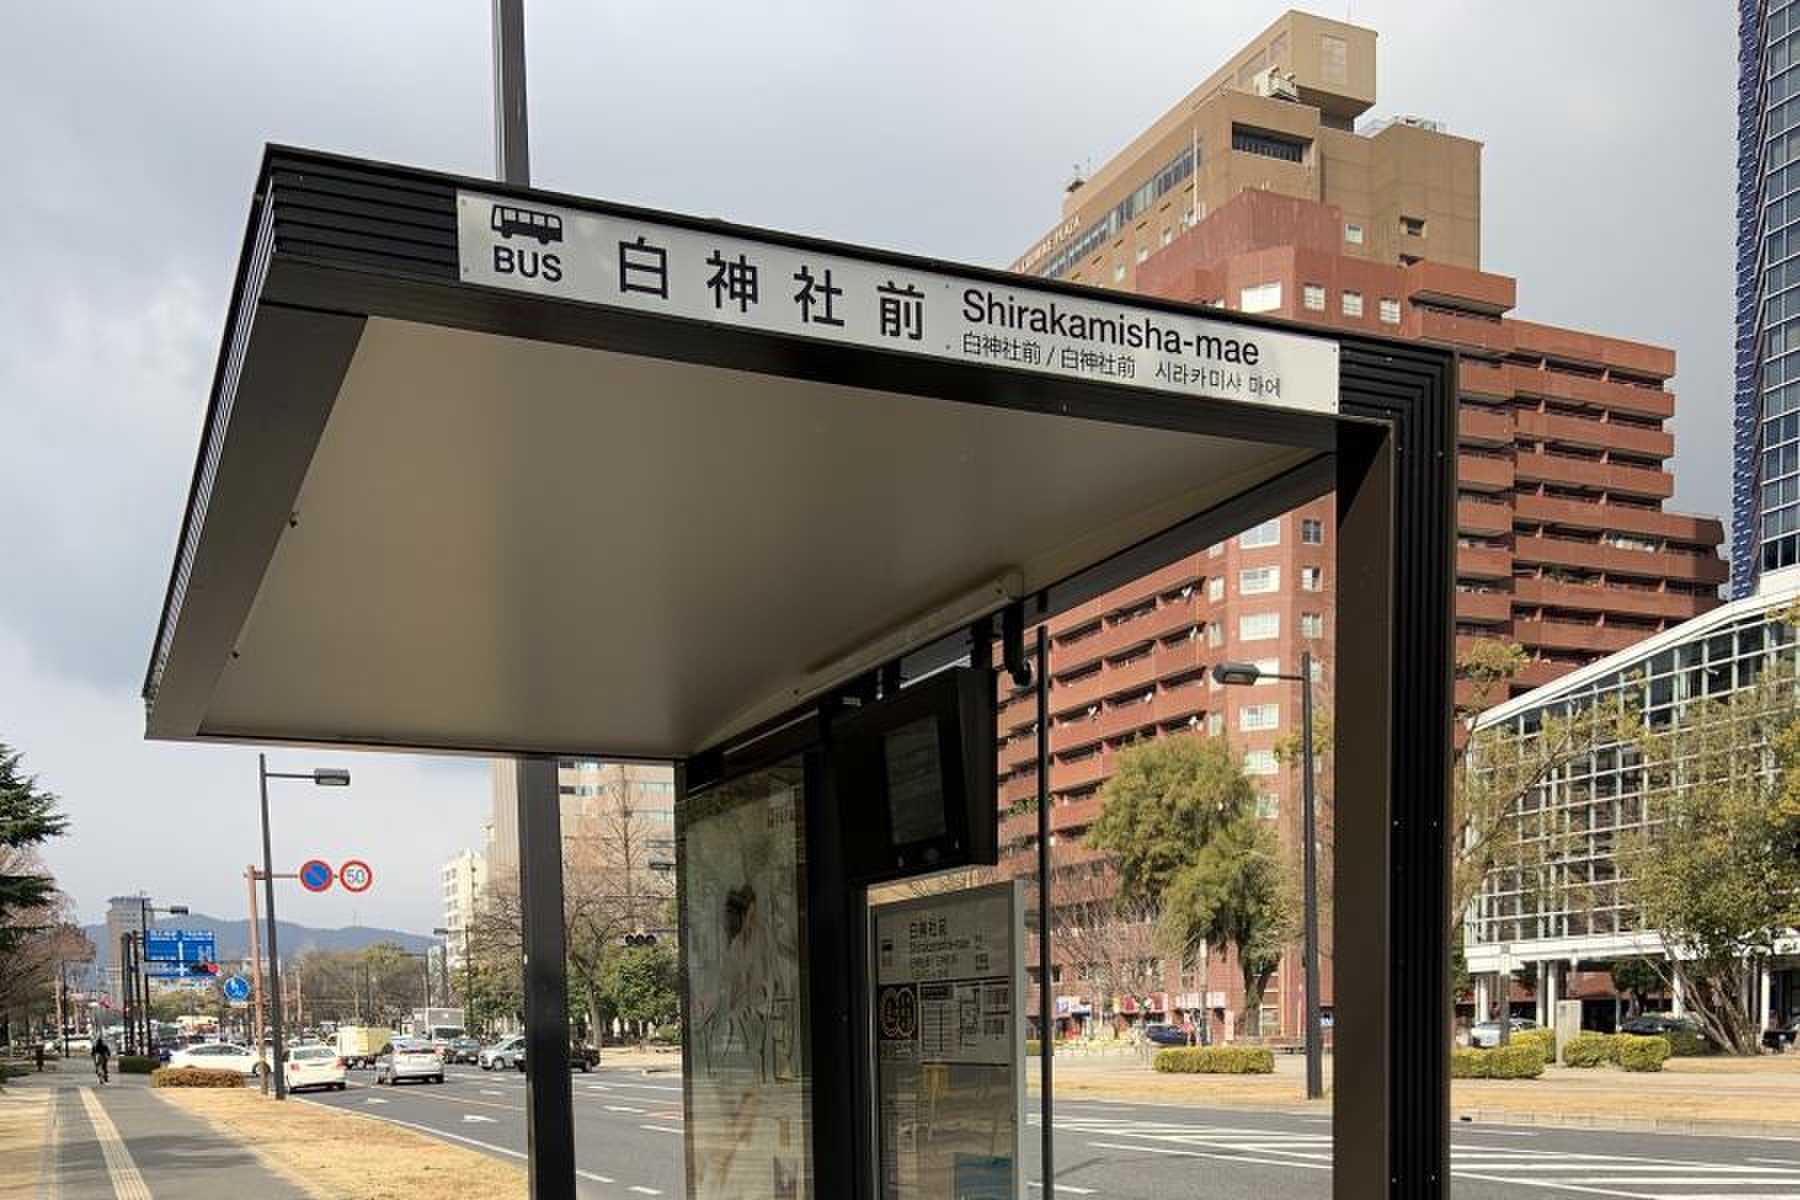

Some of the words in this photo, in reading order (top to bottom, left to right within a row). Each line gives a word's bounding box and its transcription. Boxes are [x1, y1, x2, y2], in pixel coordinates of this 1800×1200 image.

[494, 244, 563, 283] BUS
[618, 236, 927, 341] 白神社前
[961, 288, 1260, 366] Shirakamisha-mae
[962, 331, 1041, 366] 白神社前
[346, 869, 365, 884] 50
